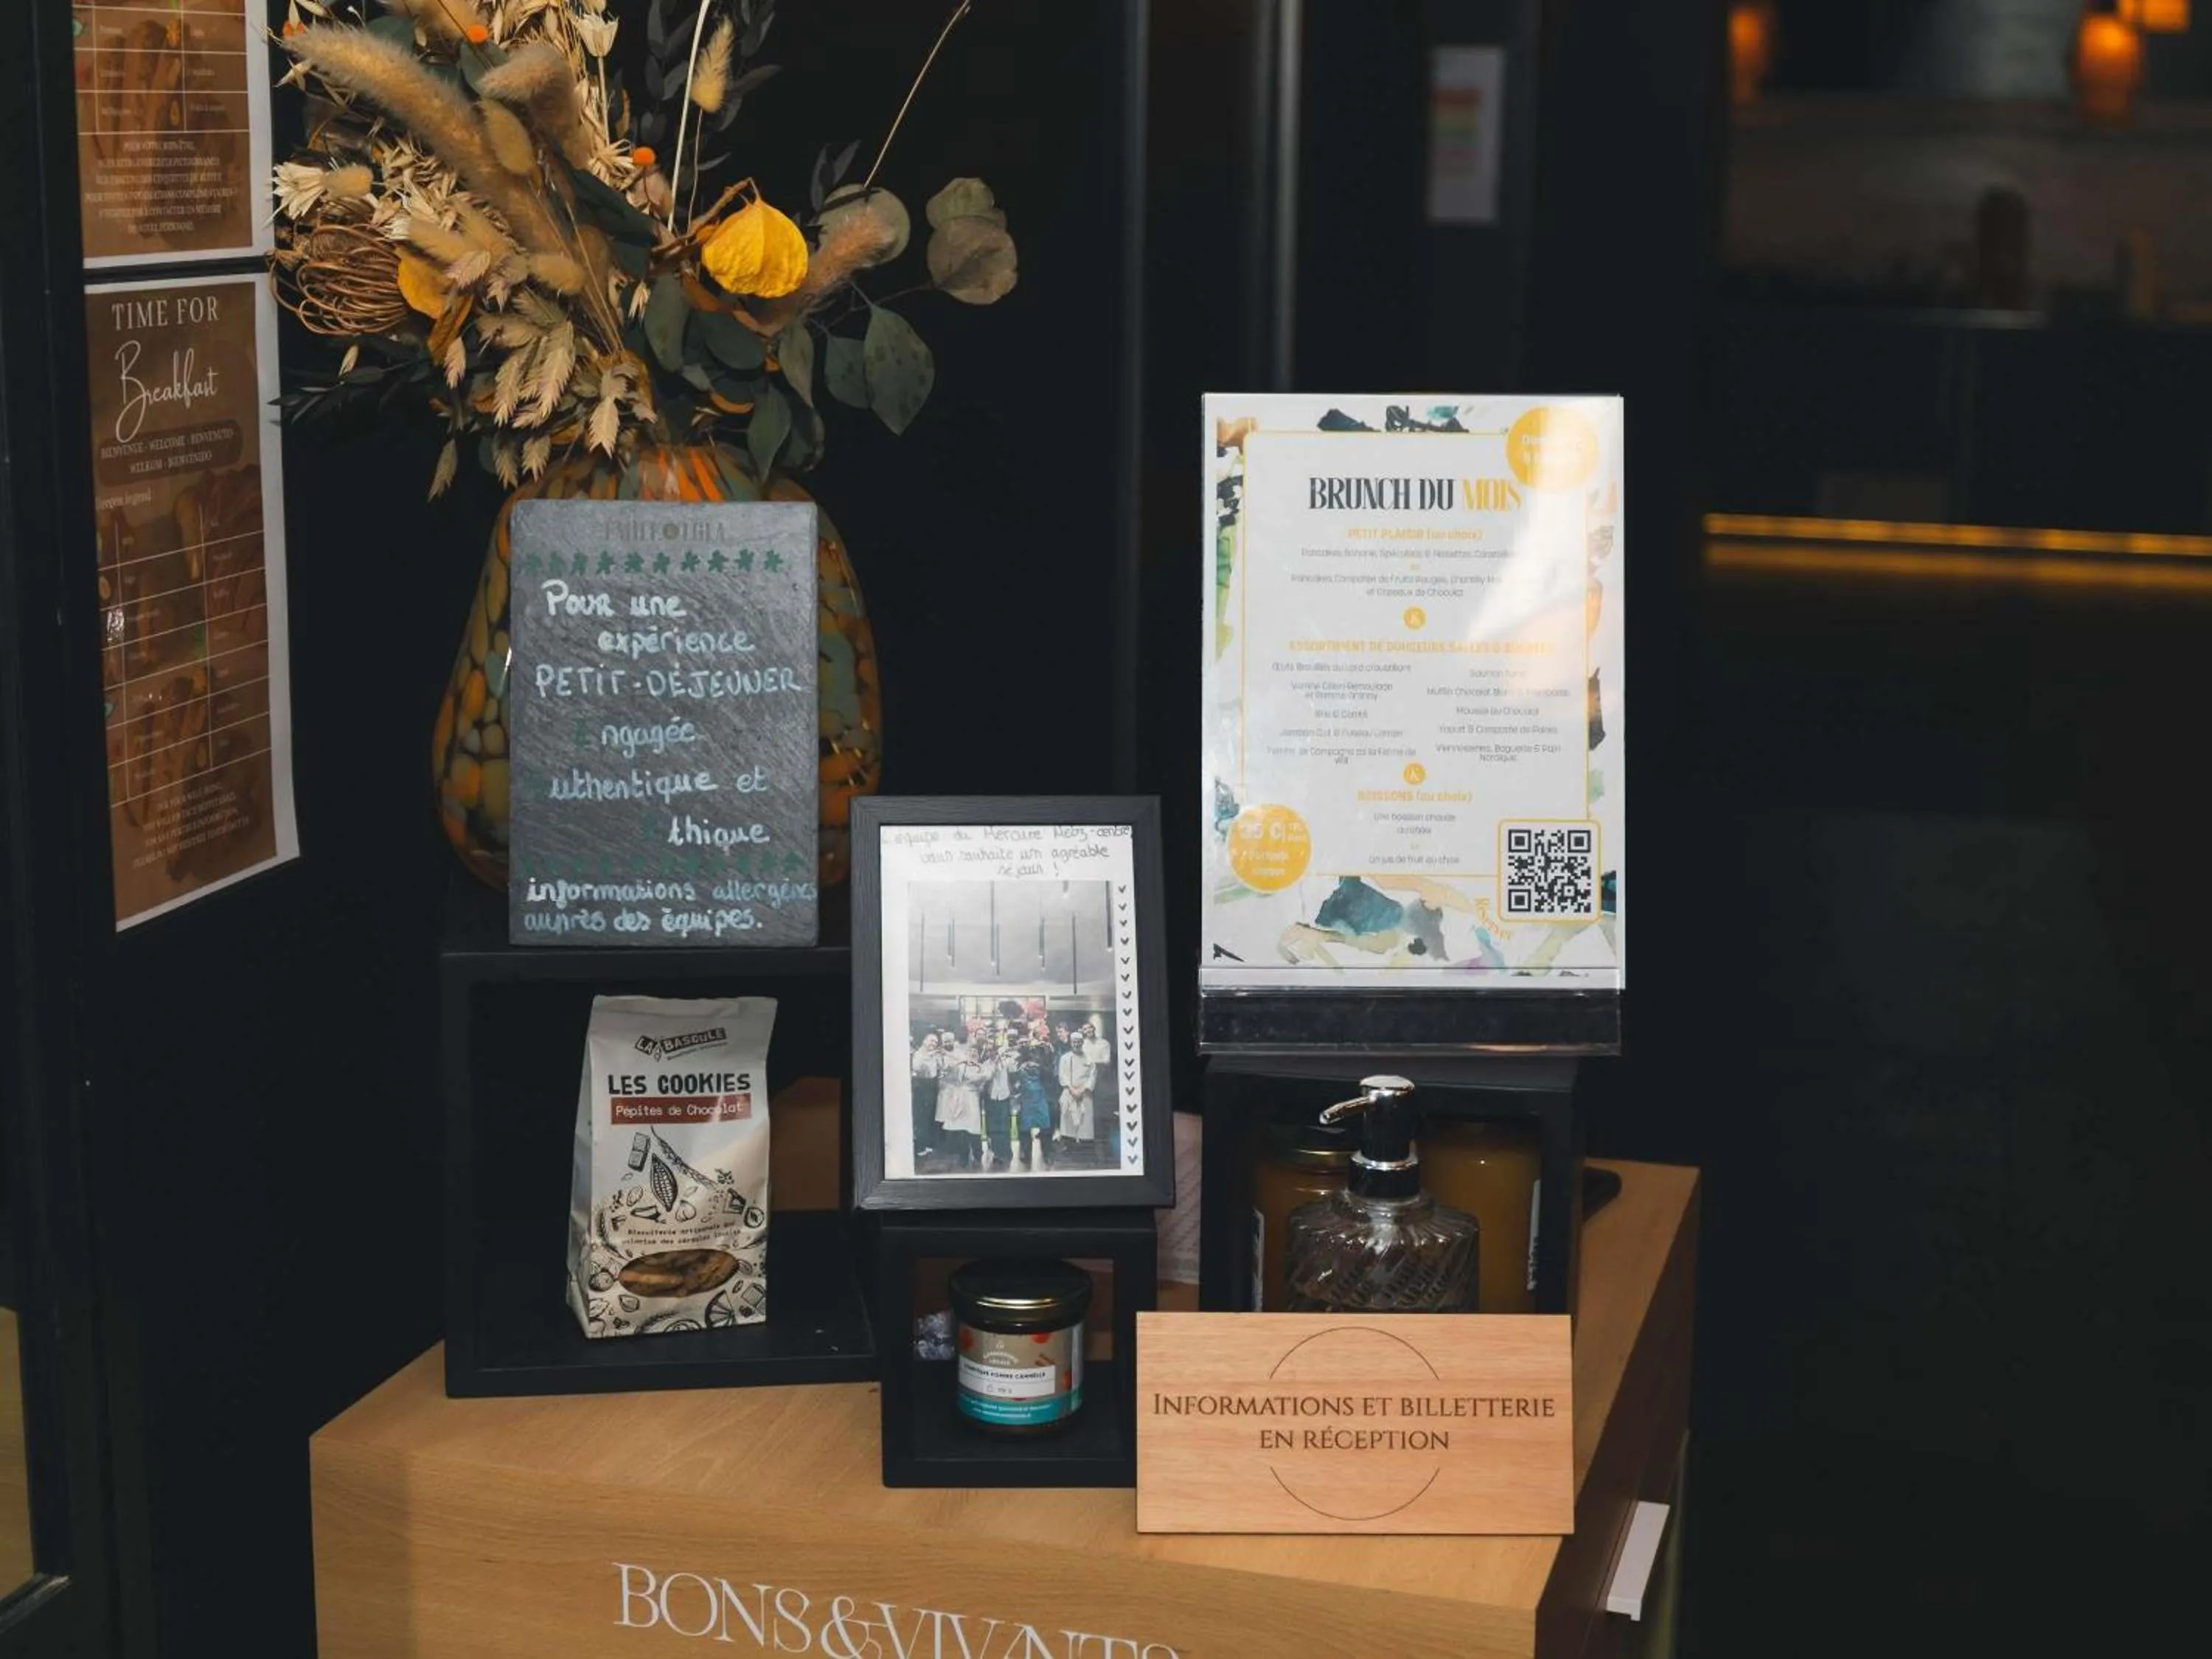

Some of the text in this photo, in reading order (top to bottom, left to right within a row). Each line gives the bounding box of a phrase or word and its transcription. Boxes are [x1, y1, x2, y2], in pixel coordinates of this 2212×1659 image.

[112, 296, 219, 330] TIME FOR
[115, 340, 218, 442] Breakfast
[1309, 476, 1522, 511] BRUNCH DU MOIS
[540, 580, 686, 618] Pour une
[574, 716, 695, 758] ngagée
[526, 765, 769, 804] uthentique et
[640, 813, 770, 854] thique
[613, 908, 652, 931] des
[663, 1028, 726, 1051] BASCULE
[608, 1073, 751, 1095] LES COOKIES
[668, 1105, 683, 1116] de
[1154, 1394, 1555, 1418] INFORMATIONS ET BILLETTERIE
[1260, 1425, 1450, 1450] EN RÉCEPTION
